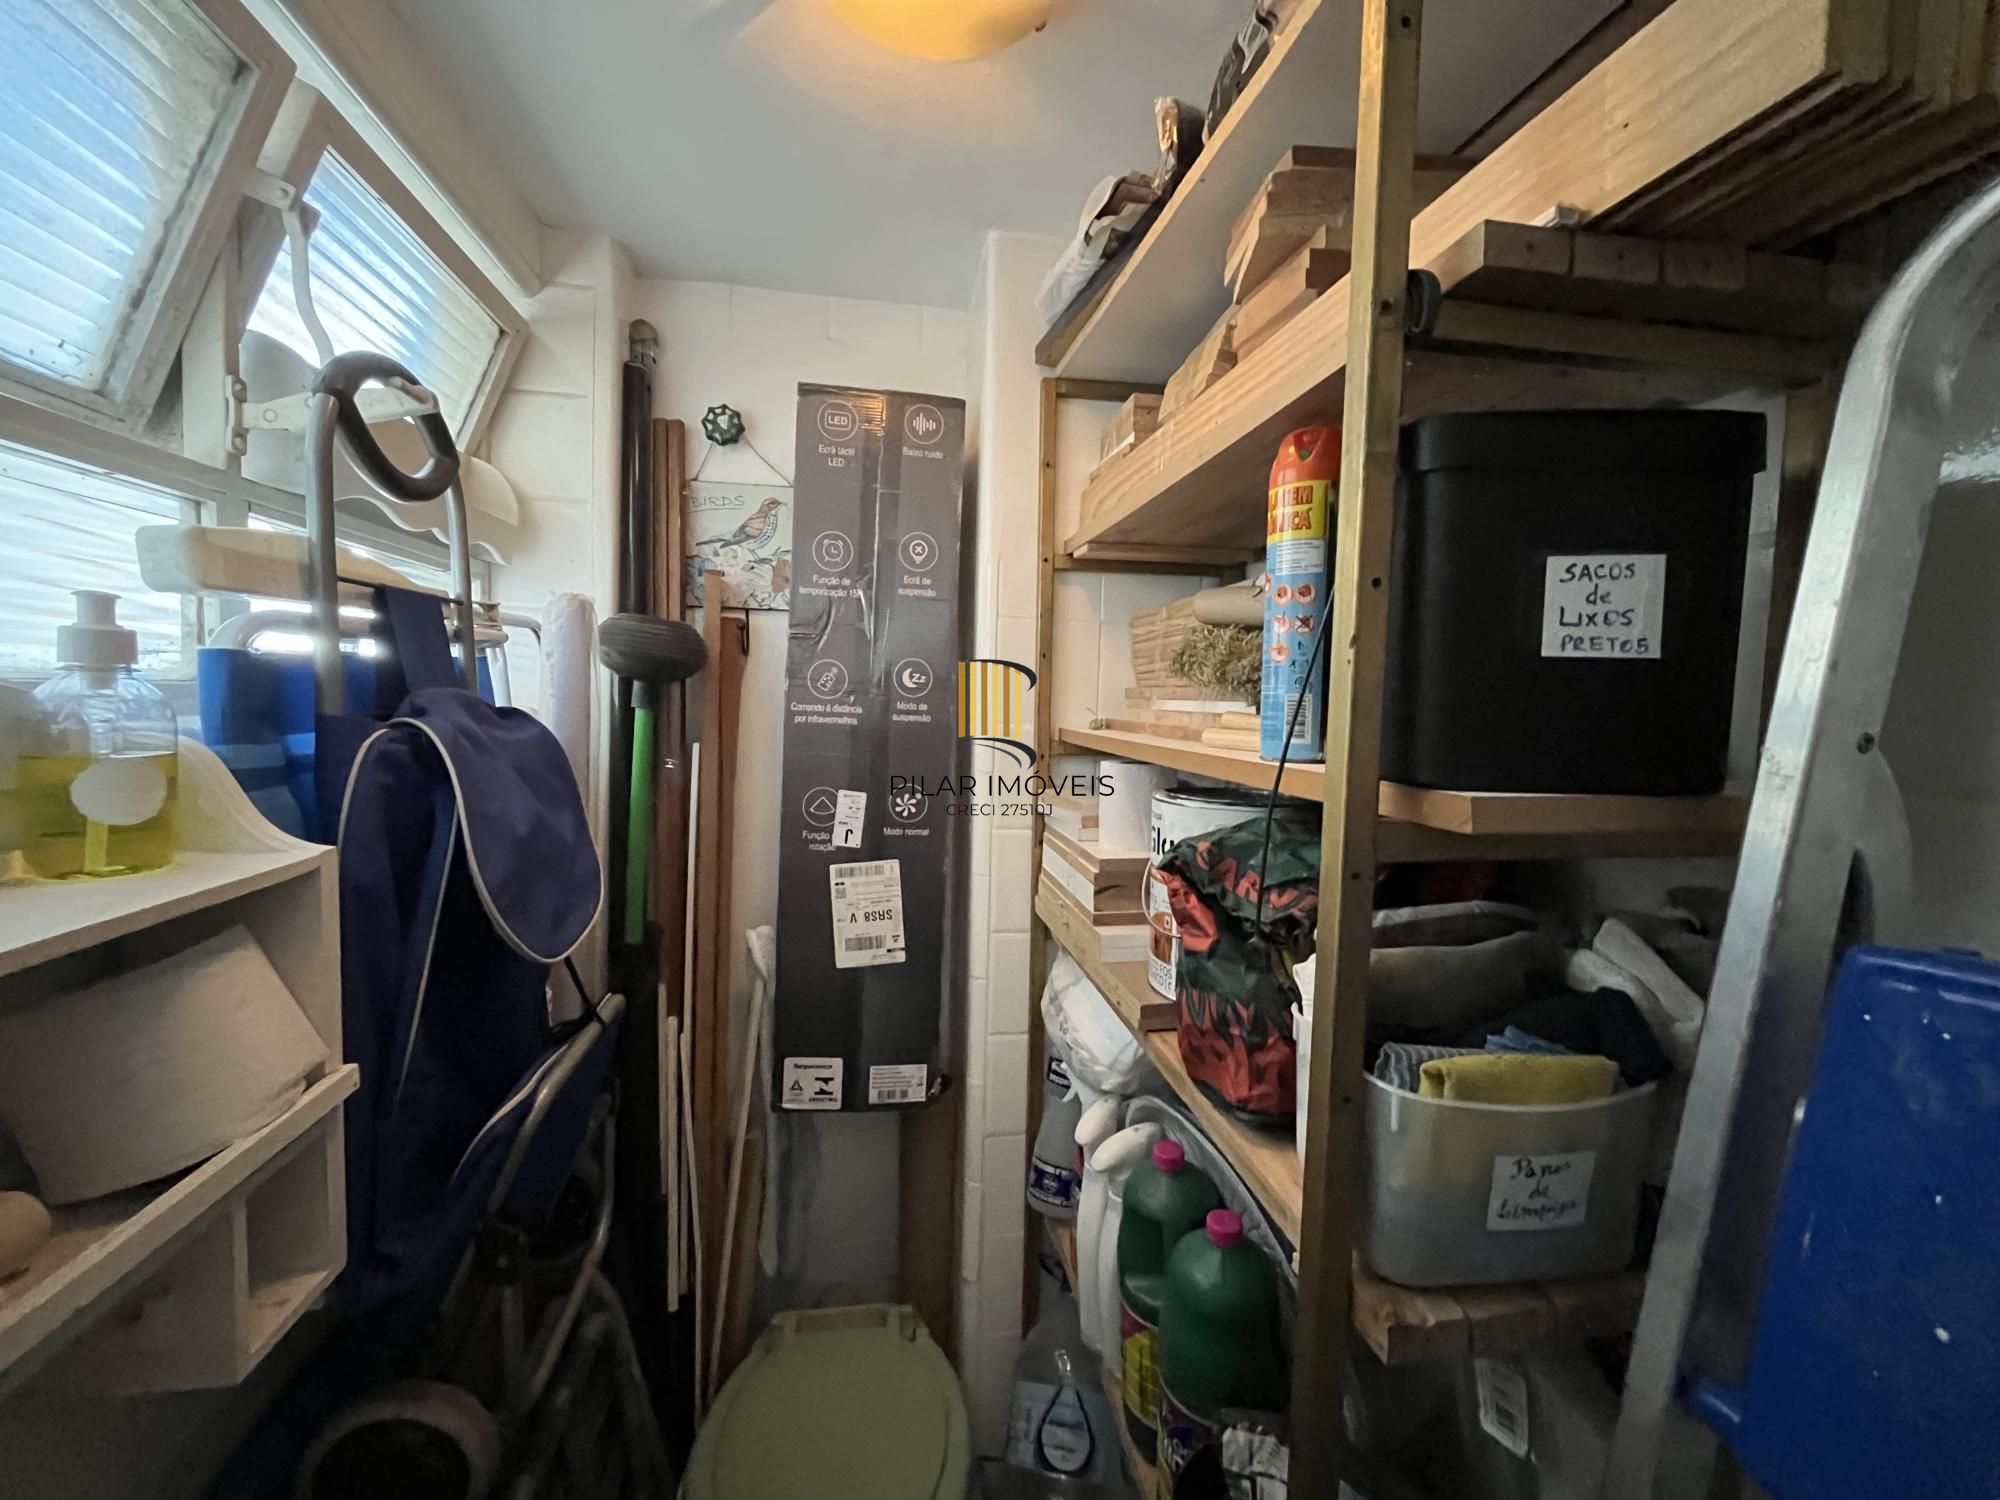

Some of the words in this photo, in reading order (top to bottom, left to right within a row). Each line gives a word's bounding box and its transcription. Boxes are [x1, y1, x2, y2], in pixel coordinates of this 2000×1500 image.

[828, 415, 848, 425] LED
[902, 446, 924, 457] Baixo
[828, 457, 845, 467] LED
[691, 495, 745, 508] BIRDS
[1559, 562, 1635, 583] SACOS
[841, 576, 851, 586] de
[1585, 583, 1612, 605] de
[1561, 634, 1649, 655] PRETOS
[897, 701, 917, 710] Modo
